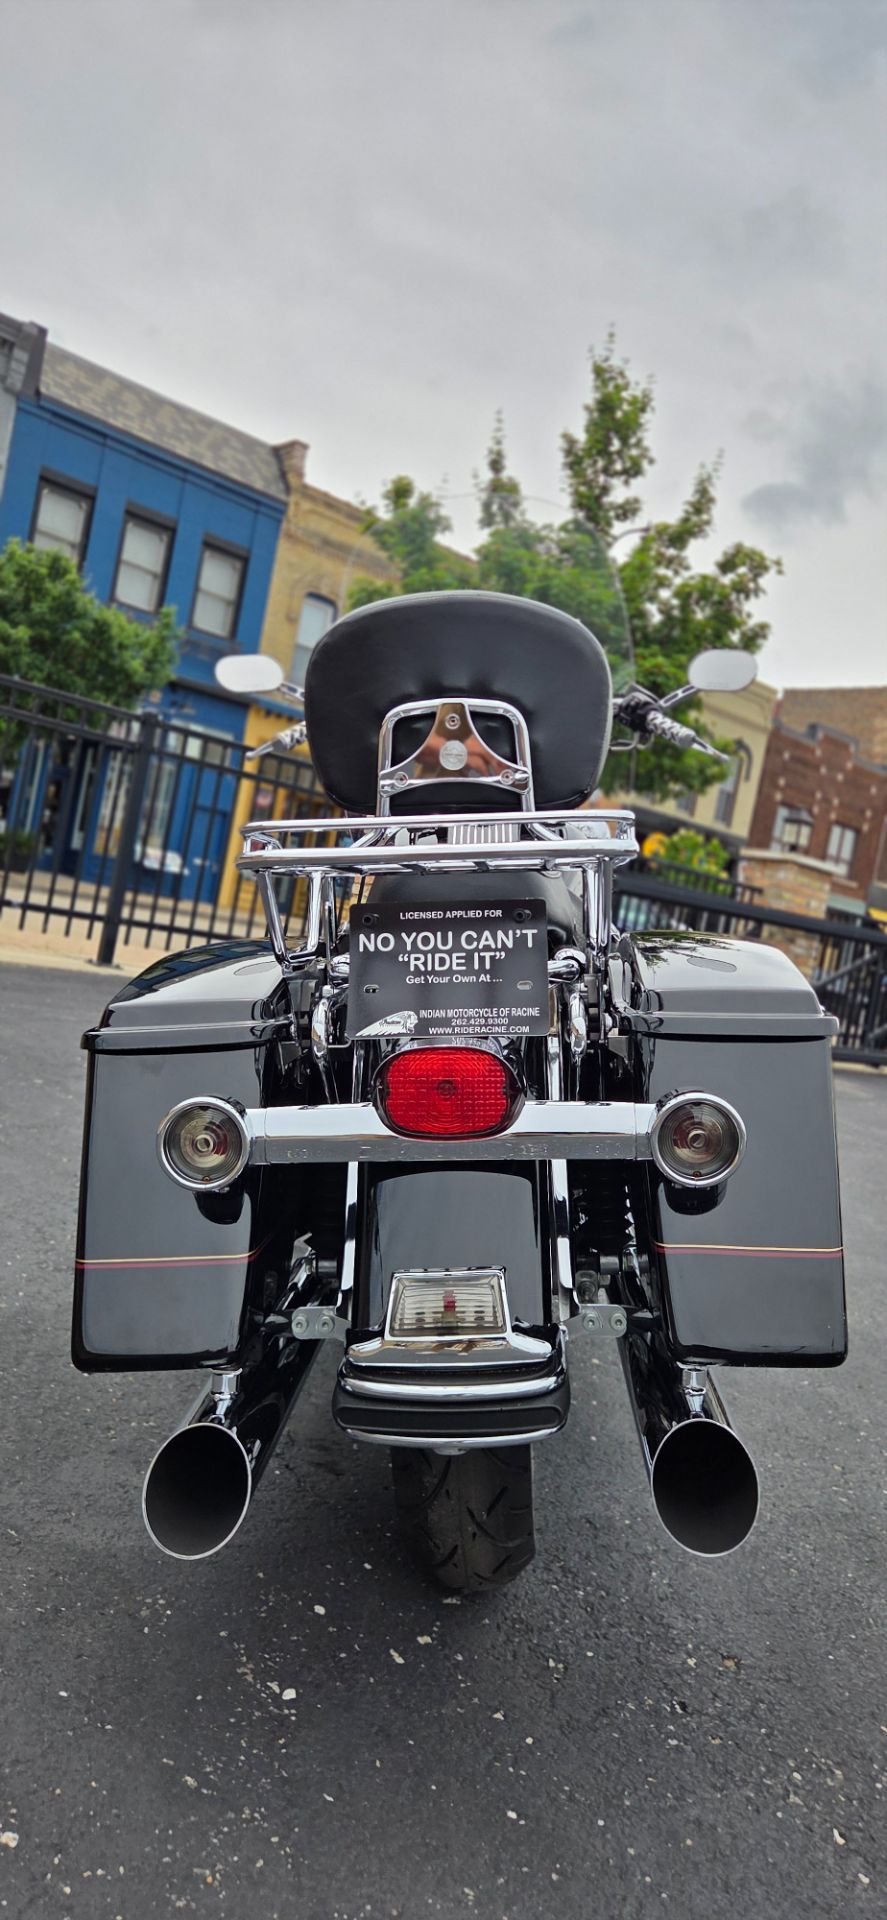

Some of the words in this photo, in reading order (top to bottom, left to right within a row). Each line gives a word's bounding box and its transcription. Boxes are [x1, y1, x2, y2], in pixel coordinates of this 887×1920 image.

[400, 911, 443, 919] LICENSED
[445, 910, 482, 918] APPLIED
[484, 910, 502, 918] FOR
[359, 933, 395, 952] NO
[401, 931, 452, 951] YOU
[406, 976, 425, 984] Get
[427, 975, 450, 983] Your
[479, 974, 491, 982] At
[420, 1010, 445, 1018] INDIAN
[447, 1009, 498, 1017] MOTORCYCLE
[500, 1008, 510, 1016] OF
[511, 1008, 540, 1016] RACINE
[429, 1026, 529, 1034] WWW.RIDERACINE.COM
